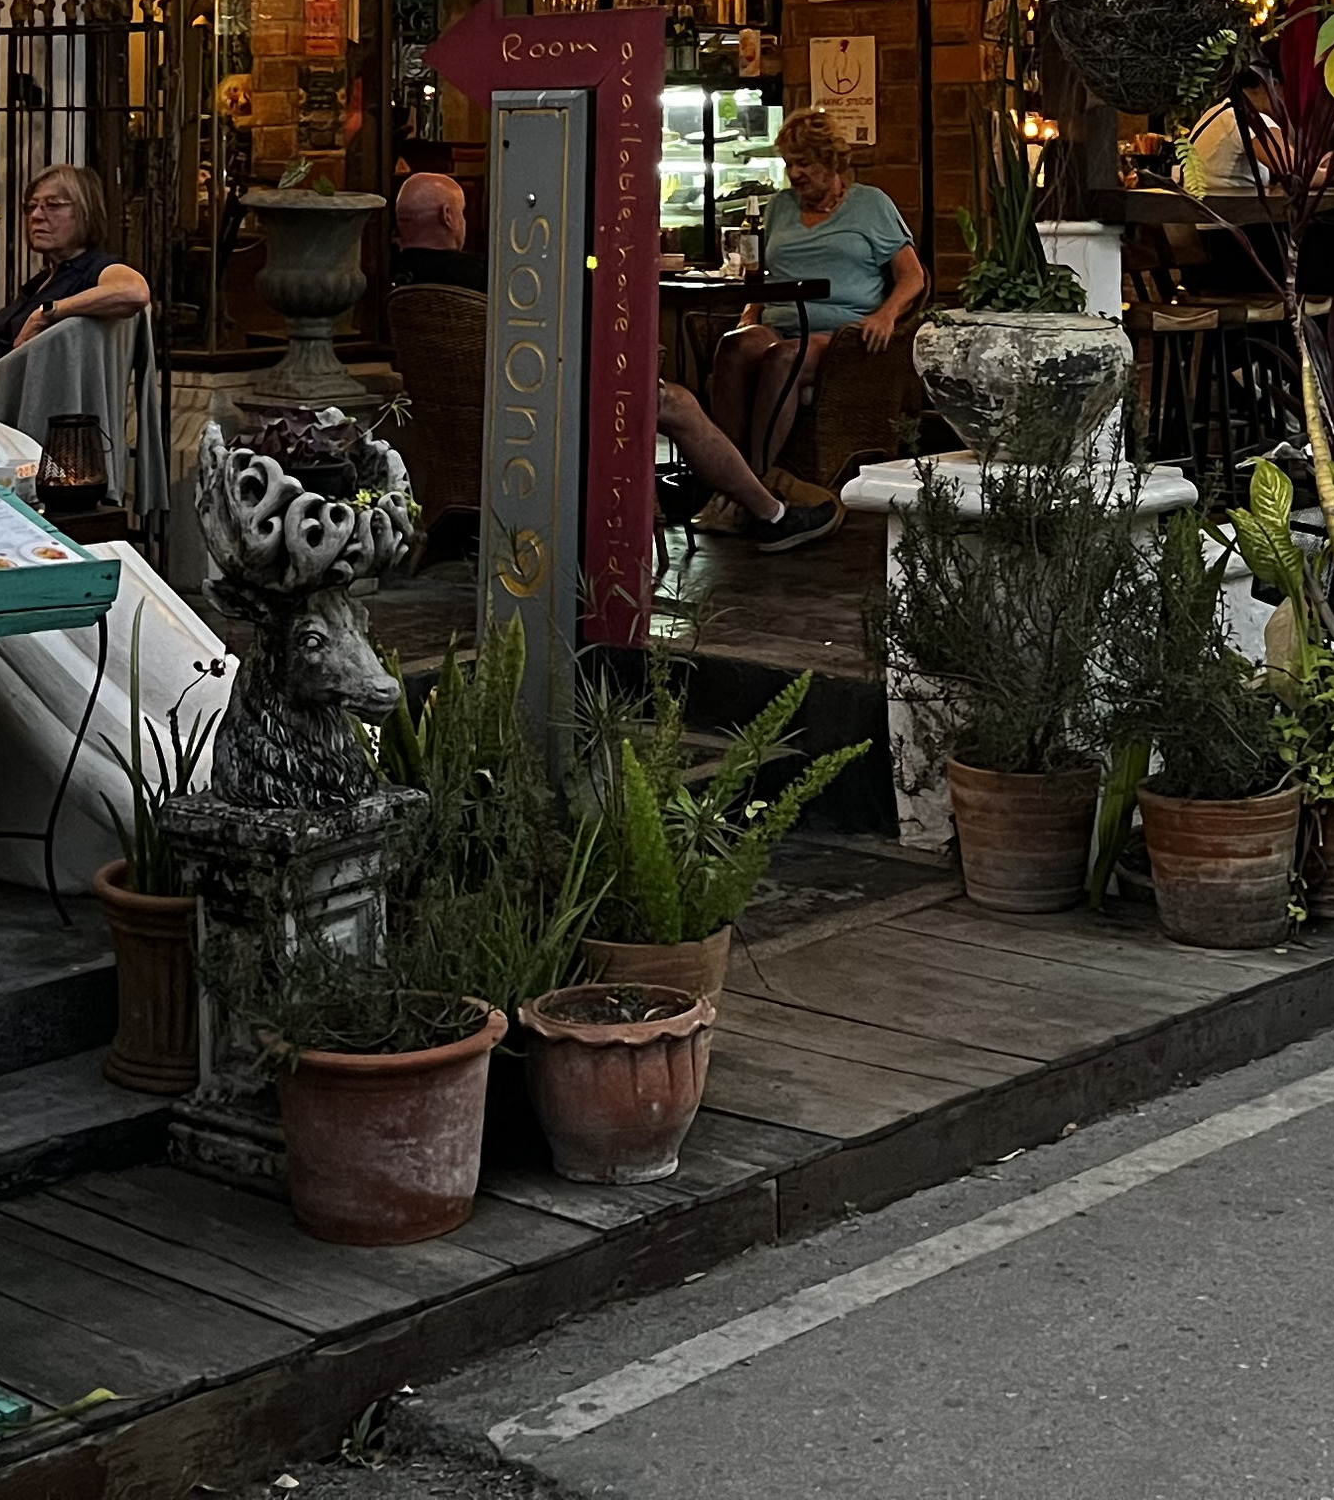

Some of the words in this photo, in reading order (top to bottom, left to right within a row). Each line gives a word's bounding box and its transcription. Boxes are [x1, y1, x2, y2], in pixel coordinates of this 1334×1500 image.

[502, 33, 598, 62] Room
[616, 353, 628, 375] a
[612, 390, 633, 454] look
